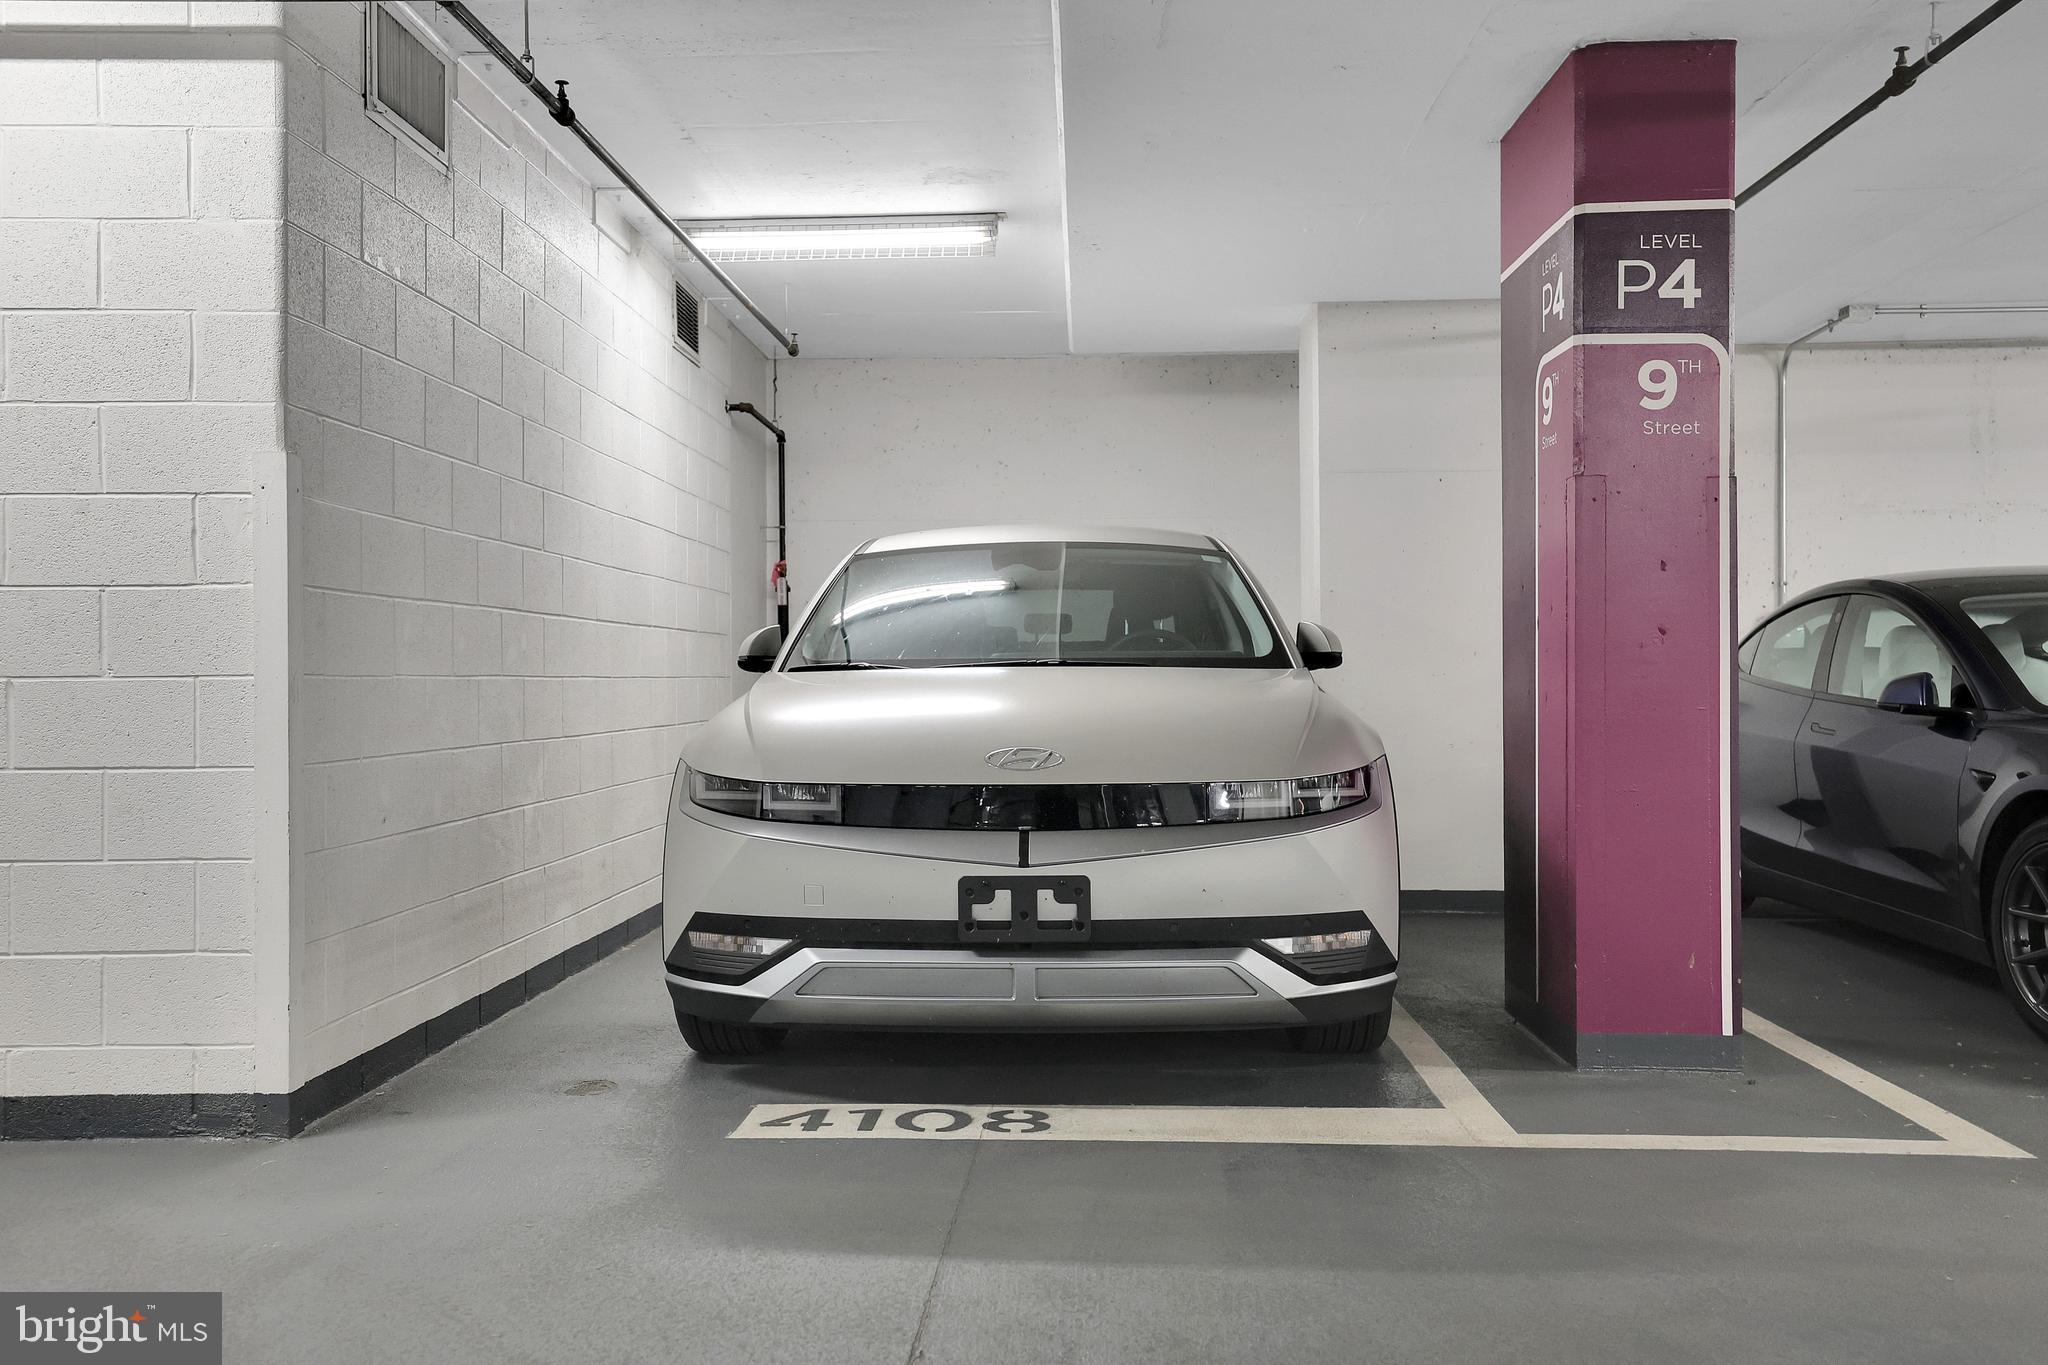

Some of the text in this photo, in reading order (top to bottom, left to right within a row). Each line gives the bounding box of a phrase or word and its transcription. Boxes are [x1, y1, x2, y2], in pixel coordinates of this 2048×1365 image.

[1640, 234, 1702, 249] LEVEL
[1617, 258, 1702, 310] P4
[1542, 271, 1565, 333] P4
[1637, 359, 1701, 410] 9TH
[1643, 420, 1701, 435] Street
[1542, 432, 1559, 449] Street
[759, 1108, 1051, 1133] 4108
